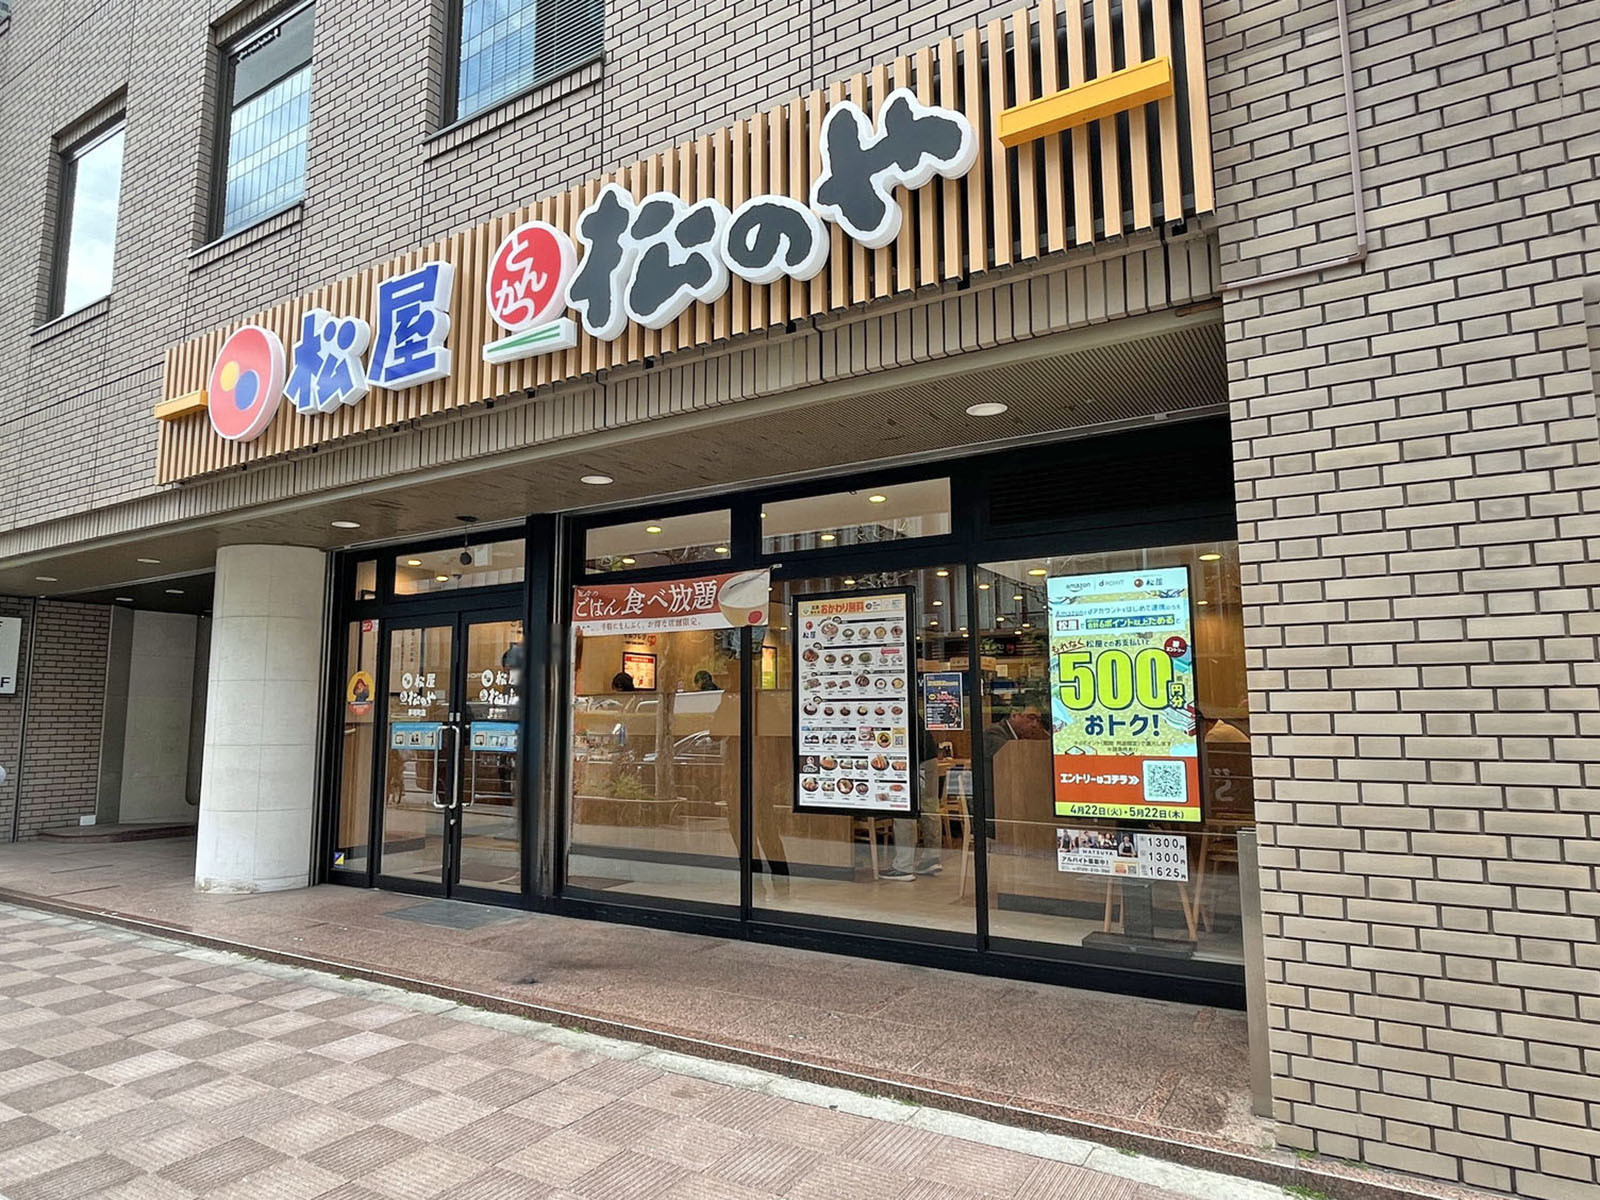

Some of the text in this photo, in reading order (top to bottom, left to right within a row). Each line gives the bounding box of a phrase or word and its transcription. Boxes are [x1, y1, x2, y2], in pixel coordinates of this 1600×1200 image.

[565, 94, 966, 330] 松のや
[494, 234, 548, 325] とんかつ
[286, 263, 448, 412] 松屋
[575, 579, 718, 618] ごはん食べ放題
[1084, 713, 1161, 737] おトク!
